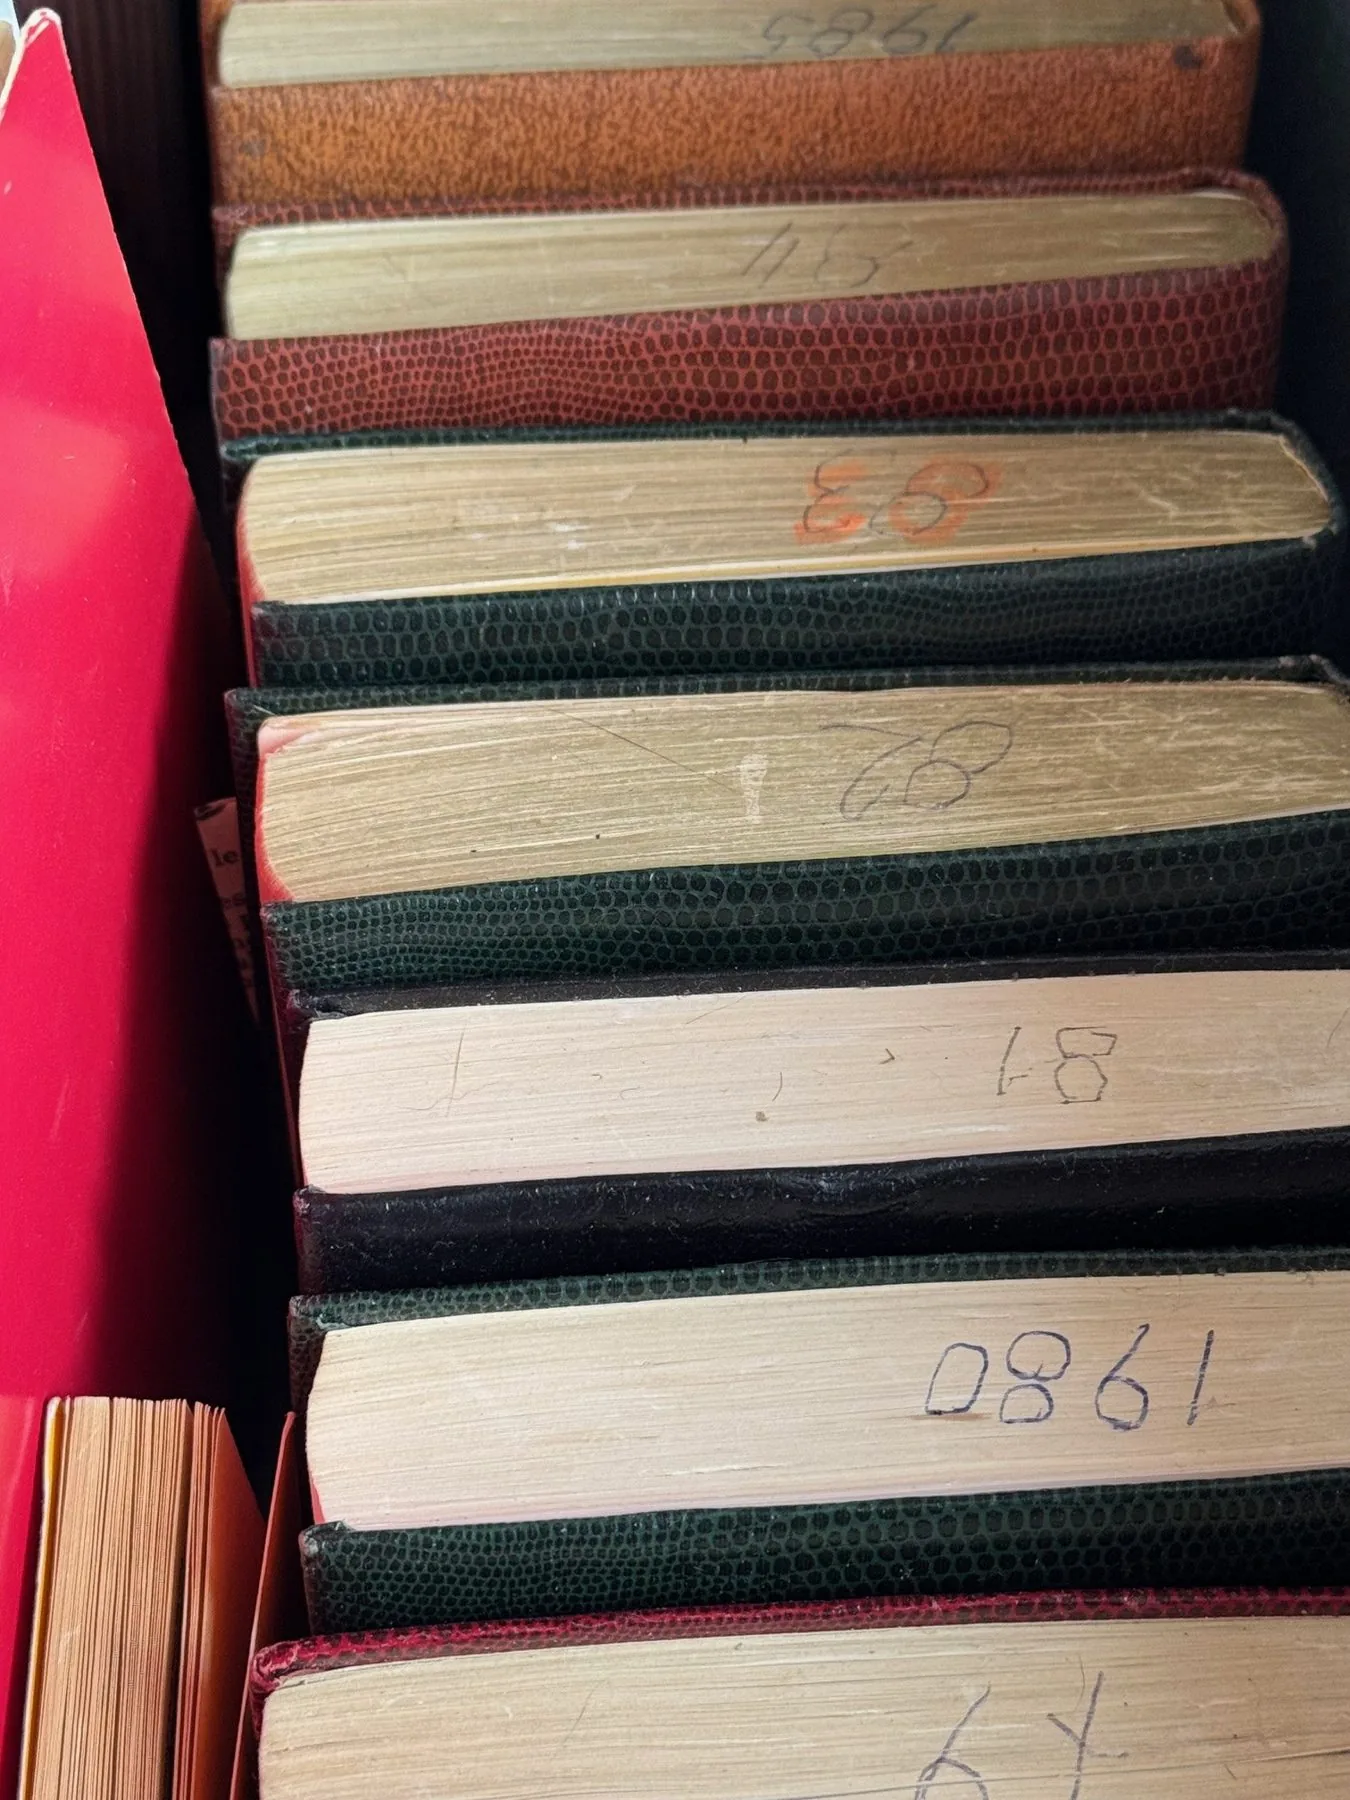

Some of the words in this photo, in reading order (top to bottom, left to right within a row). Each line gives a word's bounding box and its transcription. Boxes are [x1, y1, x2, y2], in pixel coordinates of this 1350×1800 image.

[743, 4, 979, 59] 1985
[793, 450, 1003, 545] 83
[818, 720, 1013, 821] 82
[997, 1026, 1117, 1104] 81
[924, 1323, 1214, 1431] 1980
